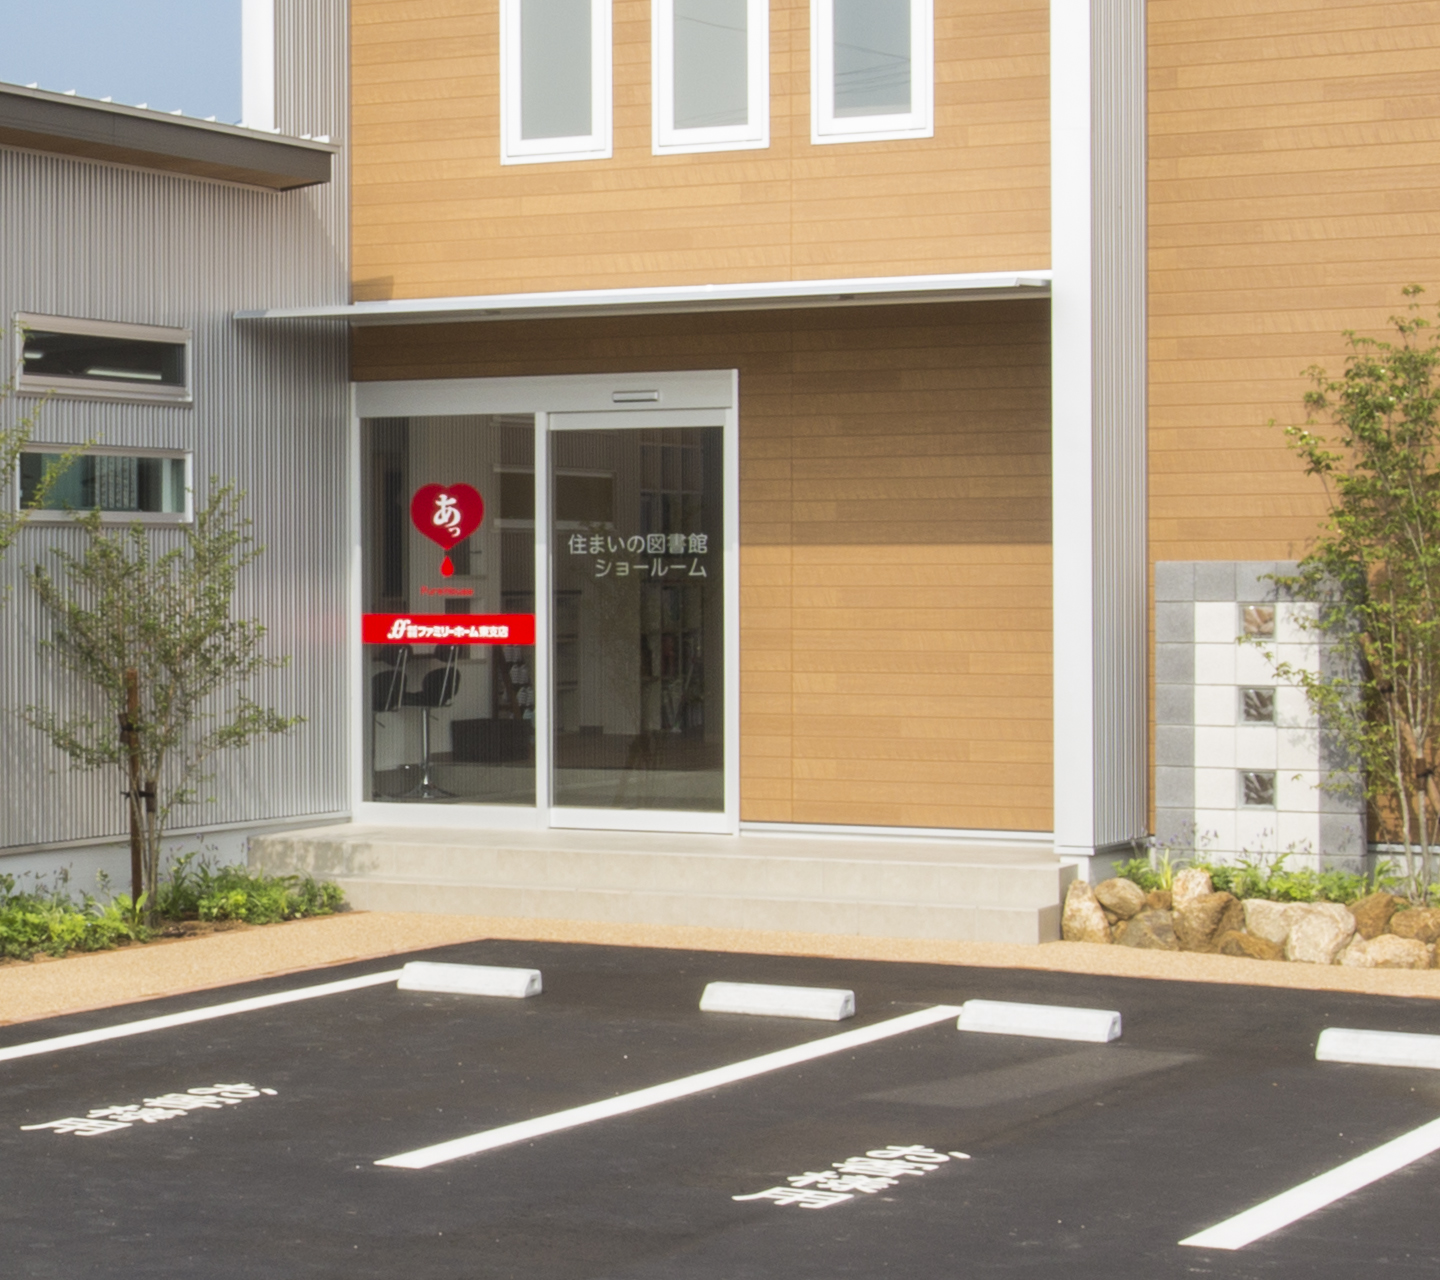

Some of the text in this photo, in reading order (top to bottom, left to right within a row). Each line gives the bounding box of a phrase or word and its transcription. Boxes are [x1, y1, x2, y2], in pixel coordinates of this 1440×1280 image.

[433, 494, 461, 538] あっ
[568, 533, 708, 554] 住まいの図書館
[595, 558, 707, 577] ショールーム
[20, 1083, 278, 1136] お客様用
[731, 1145, 971, 1209] お客様用
